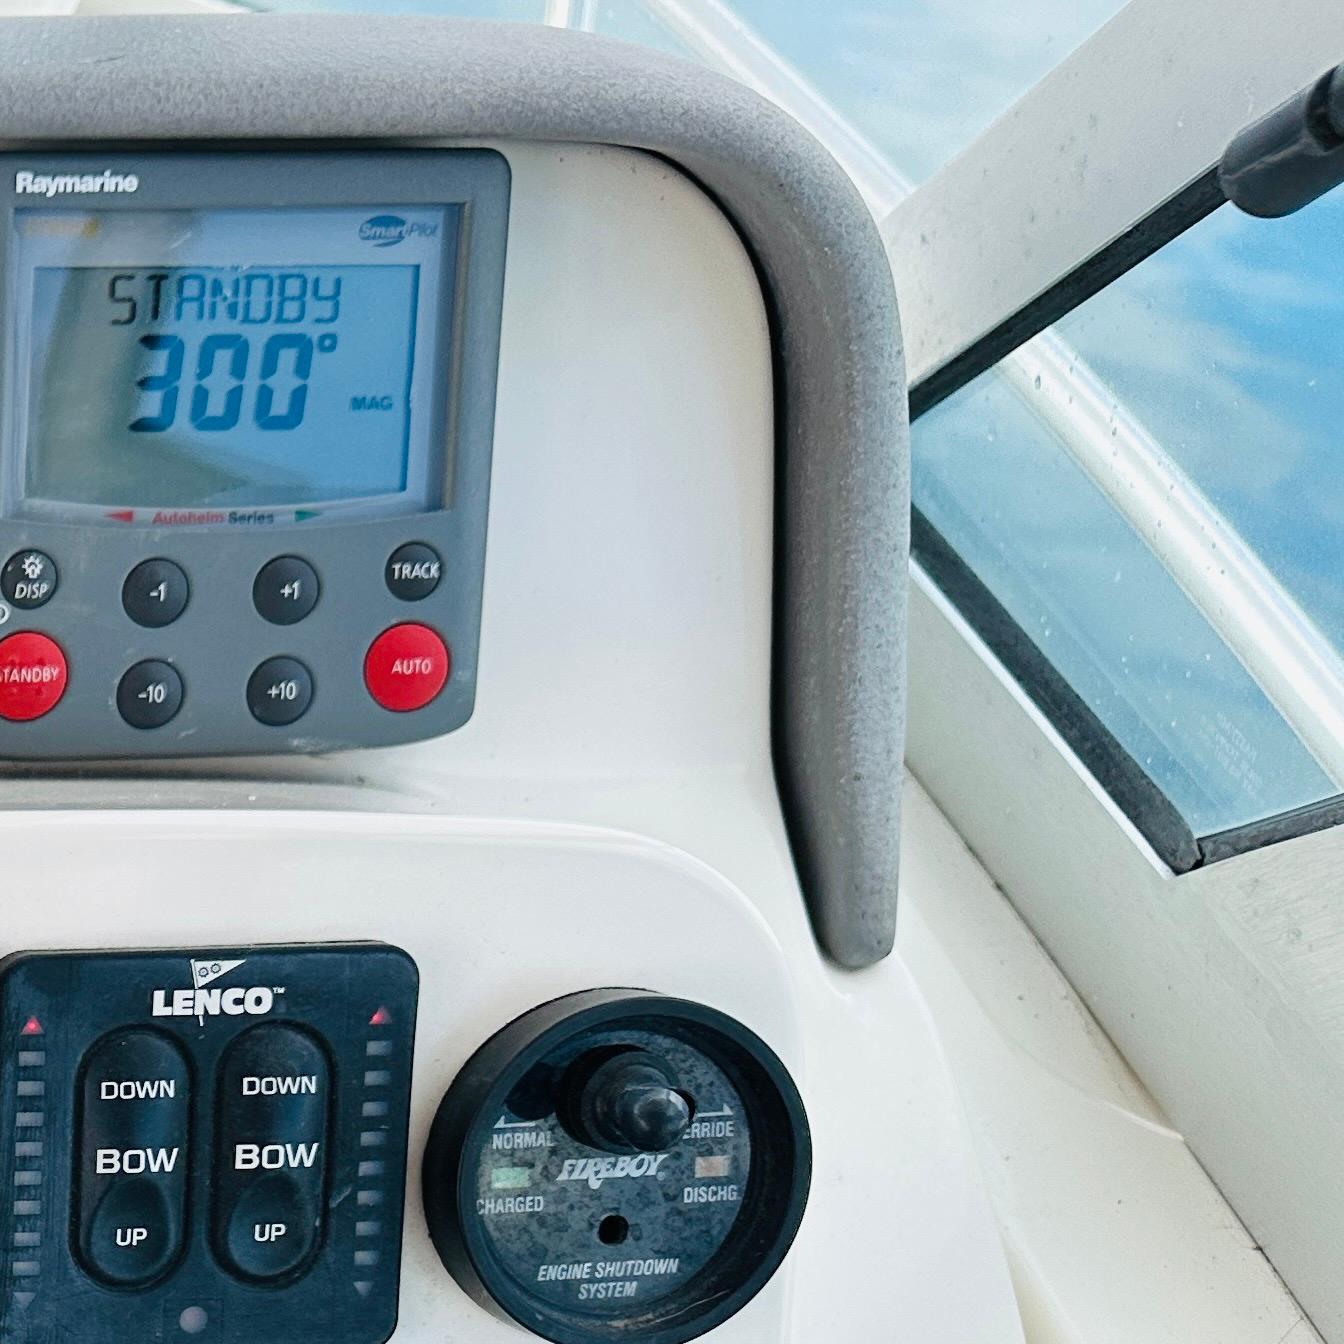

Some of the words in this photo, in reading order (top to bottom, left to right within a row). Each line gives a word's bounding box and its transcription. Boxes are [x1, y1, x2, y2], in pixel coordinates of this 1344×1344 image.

[15, 169, 139, 198] Raymarine
[110, 274, 342, 326] STANDBY
[128, 332, 338, 433] 300°
[350, 396, 393, 411] MAG
[152, 510, 225, 525] Autohelm
[228, 510, 275, 526] Series
[391, 562, 440, 580] TRACK
[14, 582, 48, 600] DISP
[148, 582, 166, 601] -1
[280, 580, 300, 600] +1
[391, 658, 432, 676] AUTO
[138, 684, 165, 703] -10
[267, 681, 297, 701] +10
[100, 1079, 176, 1100] DOWN
[242, 1075, 317, 1096] DOWN
[492, 1132, 554, 1150] NORMAL
[95, 1146, 179, 1175] BOW
[234, 1142, 319, 1170] BOW
[556, 1154, 668, 1190] FIREBOY
[684, 1185, 738, 1203] DISCHG
[477, 1196, 544, 1215] CHARGED
[115, 1227, 148, 1247] UP
[254, 1222, 286, 1242] UP
[537, 1262, 592, 1282] ENGINE
[594, 1258, 679, 1280] SHUTDOWN
[578, 1282, 637, 1300] SYSTEM
